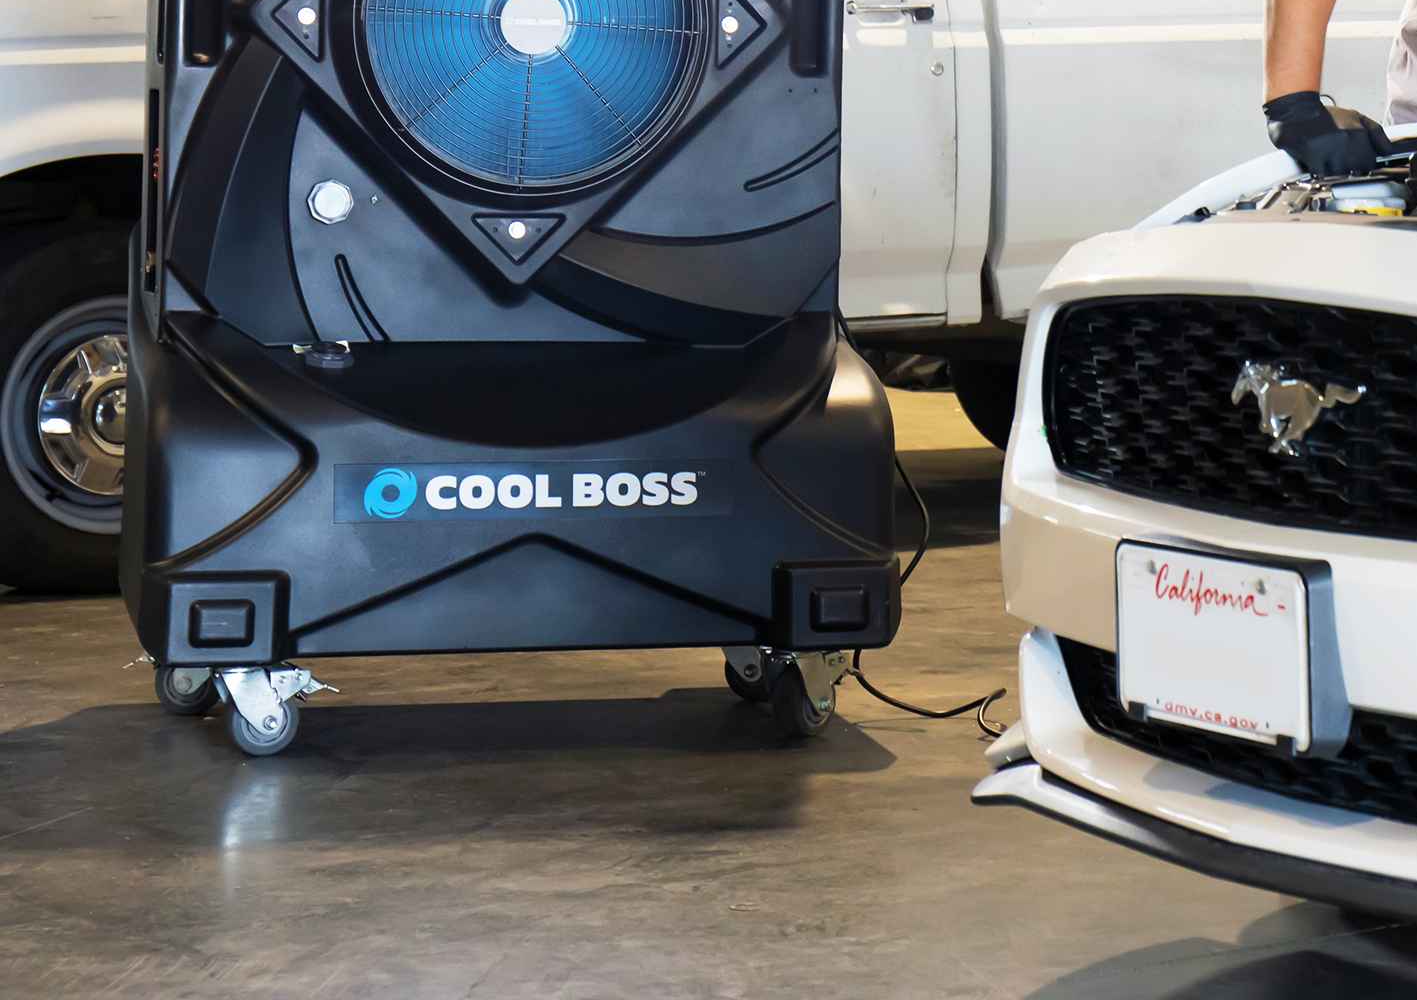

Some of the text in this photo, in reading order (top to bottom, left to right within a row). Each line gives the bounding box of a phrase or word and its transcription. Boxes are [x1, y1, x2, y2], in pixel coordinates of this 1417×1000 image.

[425, 474, 562, 510] COOL
[572, 472, 698, 508] BOSS
[1155, 563, 1269, 616] California
